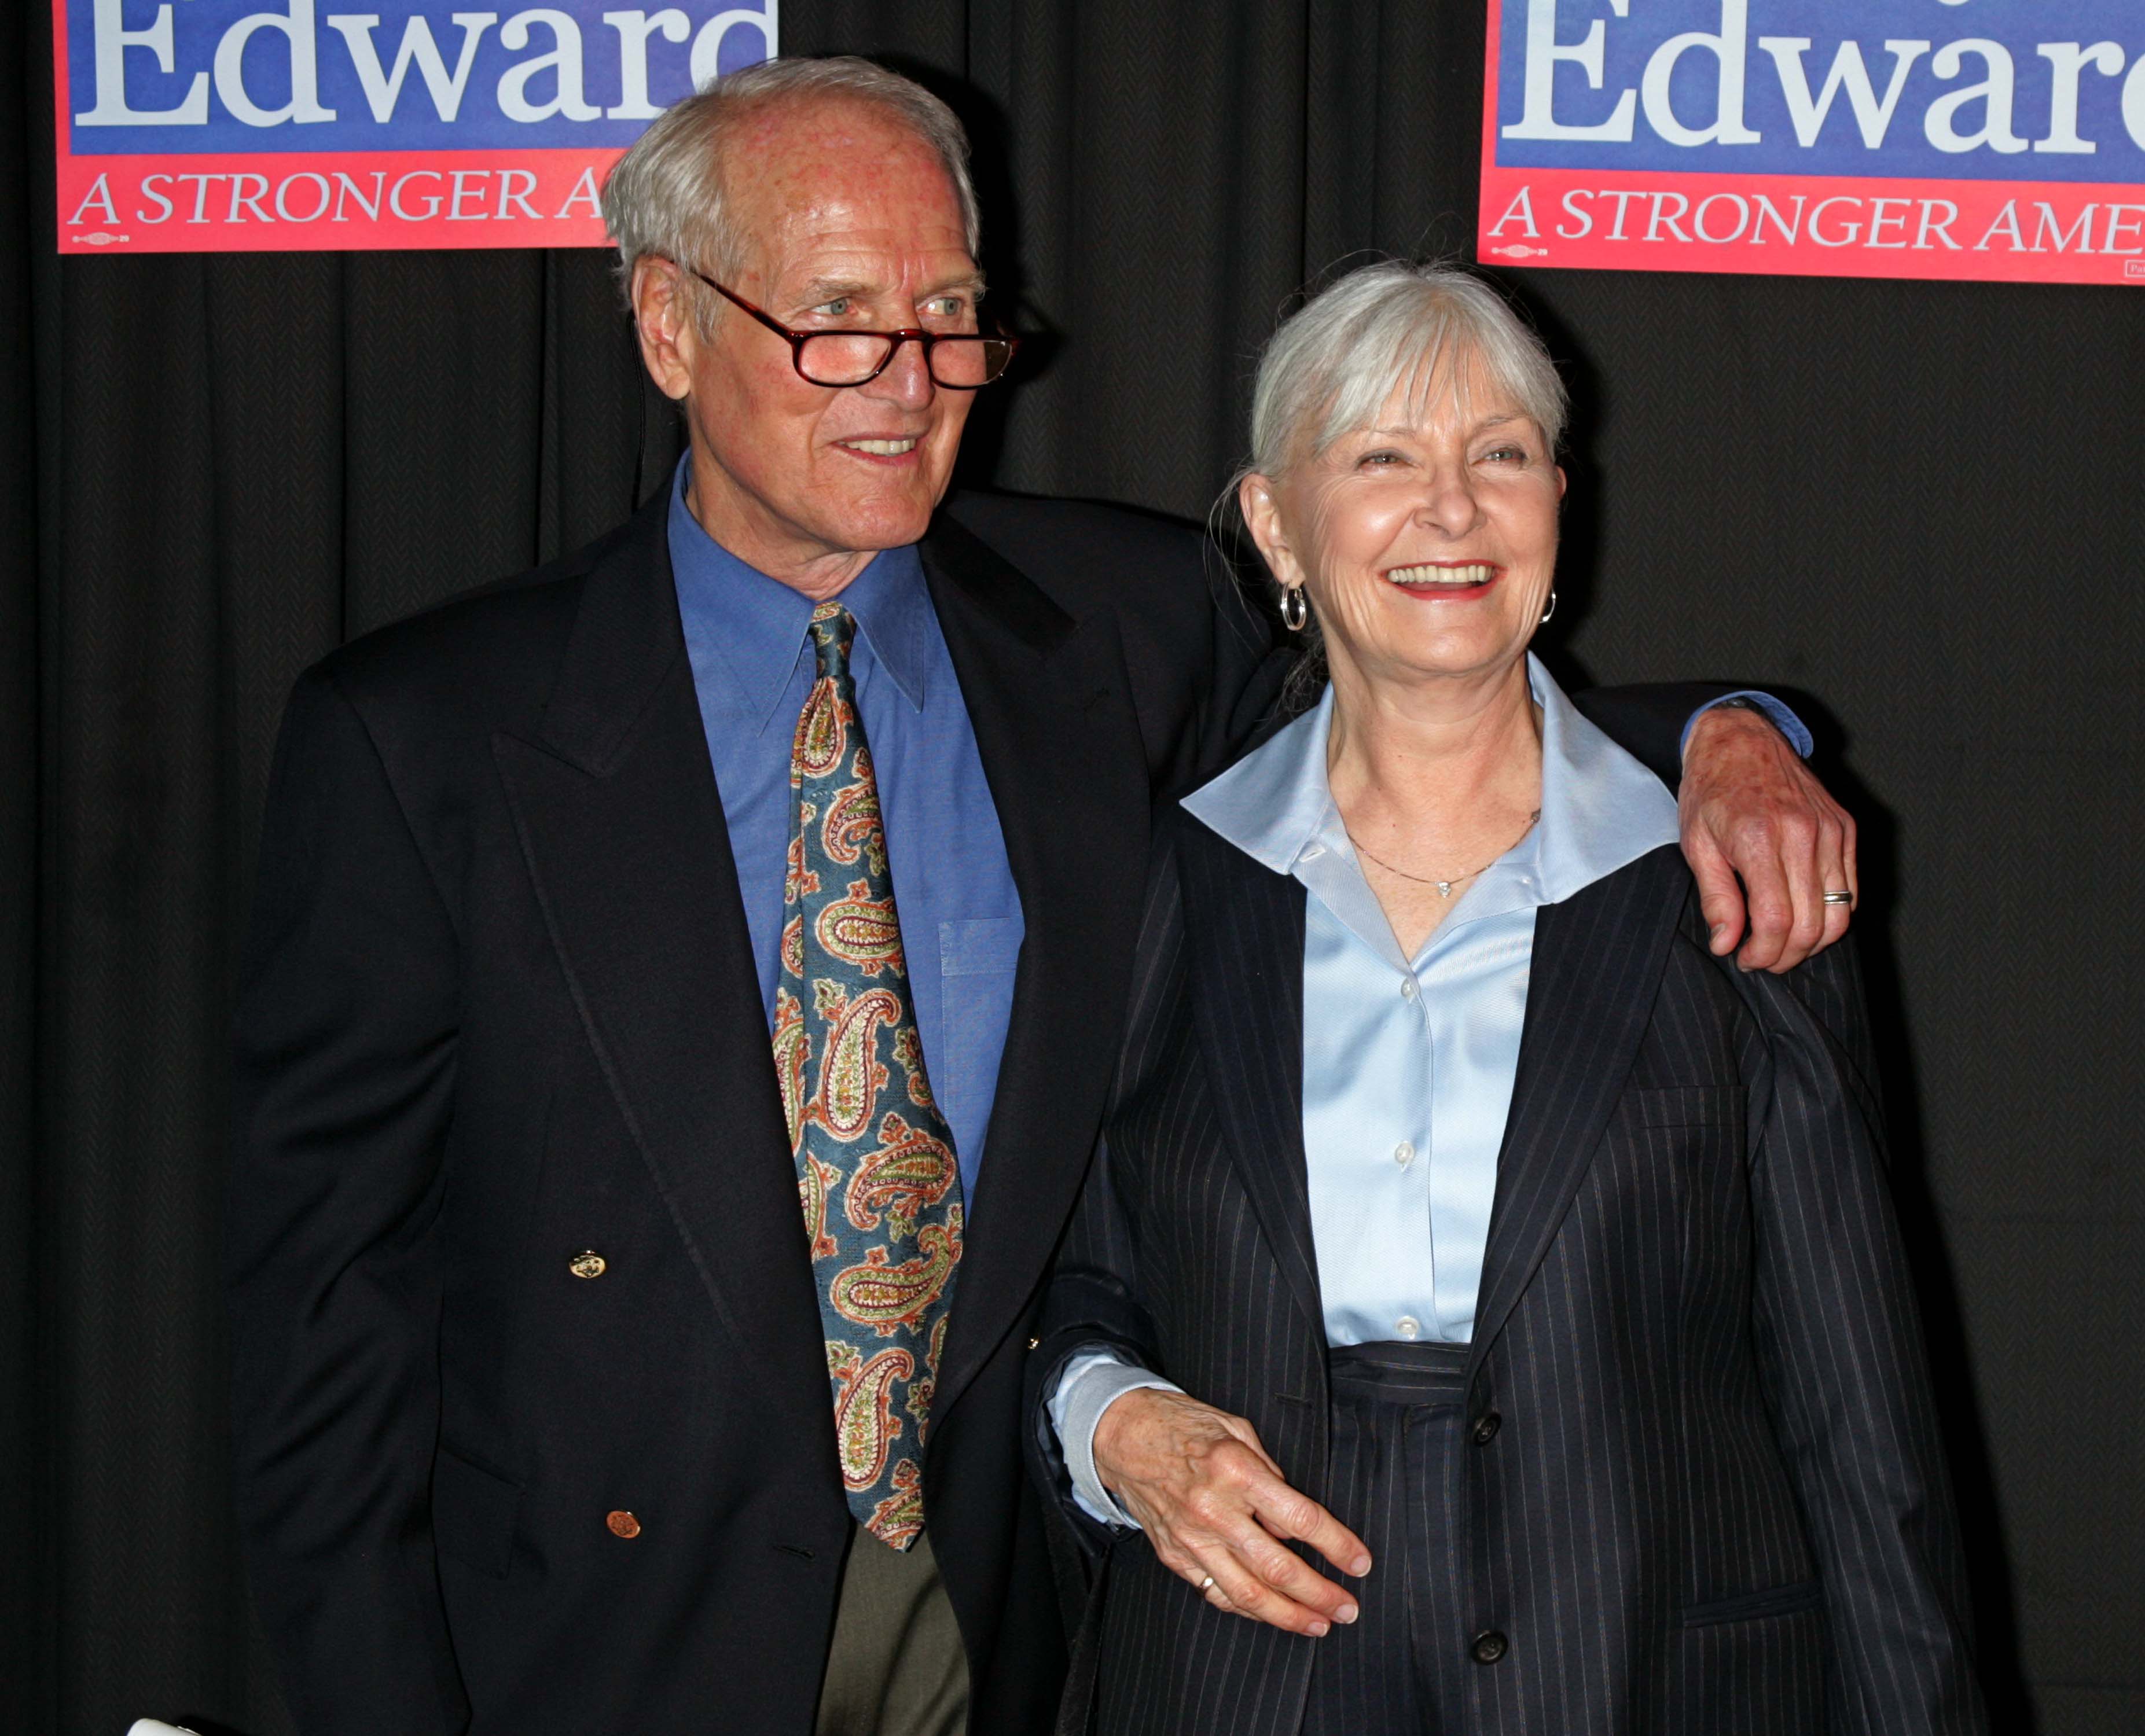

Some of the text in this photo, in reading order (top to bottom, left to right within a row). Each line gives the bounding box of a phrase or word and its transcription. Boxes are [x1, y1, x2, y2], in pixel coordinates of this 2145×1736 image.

[1501, 0, 2145, 154] Edwar
[67, 172, 121, 225] A
[137, 170, 544, 224] STRONGER
[1487, 186, 1541, 238] A
[1556, 189, 1963, 250] STRONGER
